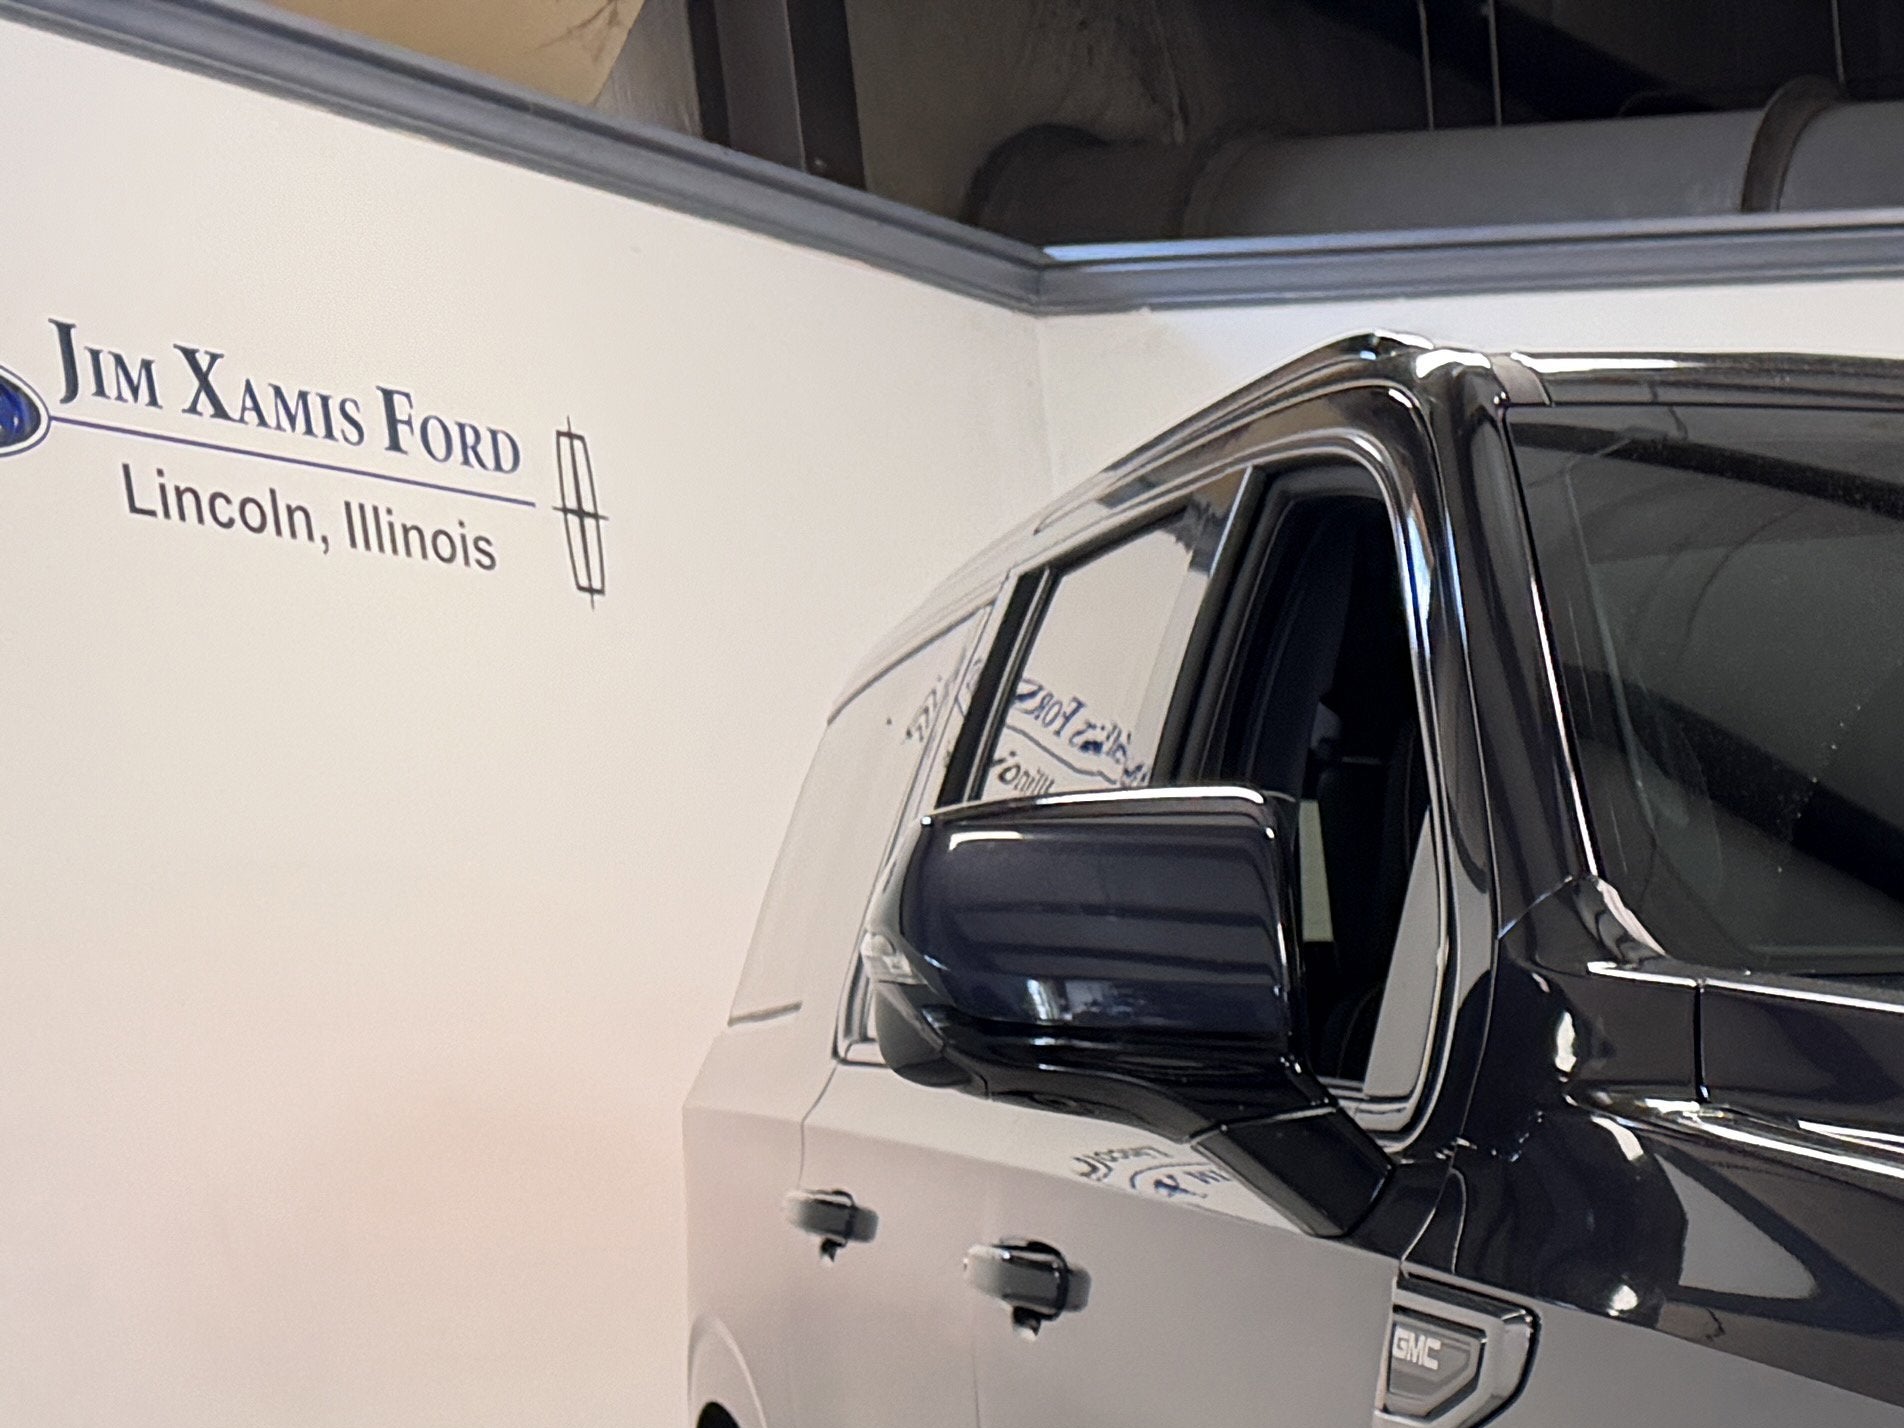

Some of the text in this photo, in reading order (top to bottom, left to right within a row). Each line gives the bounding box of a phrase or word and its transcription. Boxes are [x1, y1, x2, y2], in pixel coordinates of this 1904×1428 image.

[48, 318, 520, 474] JIM XAMIS FORD
[121, 463, 497, 571] Lincoln, Illinois
[1392, 1325, 1441, 1370] GMC
